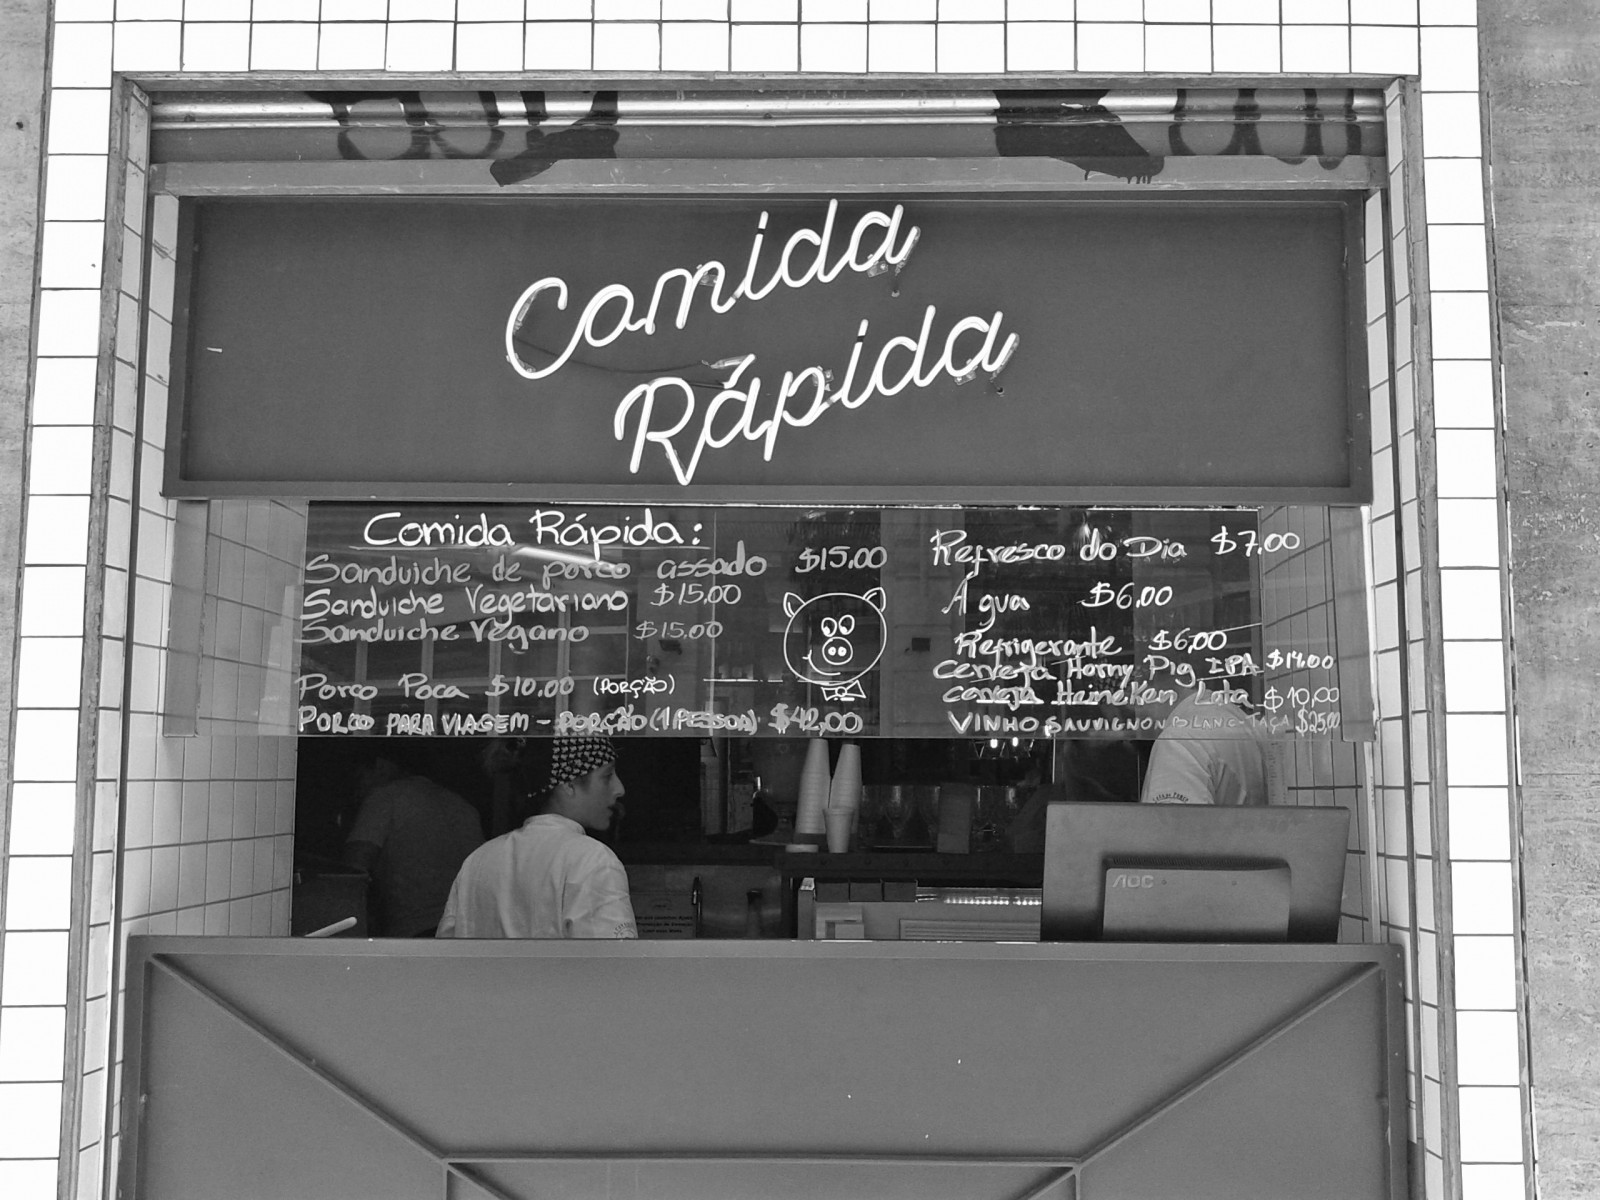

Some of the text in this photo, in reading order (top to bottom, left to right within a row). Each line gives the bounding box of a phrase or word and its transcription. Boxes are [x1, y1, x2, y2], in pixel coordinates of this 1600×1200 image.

[506, 199, 920, 379] Comida
[614, 304, 1020, 485] Rápida
[364, 512, 515, 547] Comida
[304, 554, 472, 586] Sanduiche
[492, 555, 522, 583] de
[541, 559, 631, 590] porco
[656, 540, 767, 579] assado
[930, 528, 1066, 578] Refresco
[1079, 527, 1117, 562] do
[1123, 535, 1188, 560] Dia
[300, 586, 445, 619] Sanduiche
[466, 584, 630, 628] Vegetariano
[300, 617, 460, 643] Sanduiche
[470, 618, 590, 653] Vegano
[954, 626, 1123, 668] Refrigerante
[294, 673, 378, 700] Porco
[398, 672, 470, 699] Poca
[1067, 656, 1134, 689] Horny
[1142, 654, 1197, 688] Pig
[1204, 652, 1260, 676] IPA
[1195, 679, 1255, 709] Lata
[386, 712, 435, 736] PARA
[441, 711, 530, 736] VIAGEM
[558, 703, 648, 736] PORÇÃO
[947, 711, 1040, 735] VINHO
[1045, 714, 1166, 736] SAUVIGNON
[1112, 874, 1154, 889] AOC
